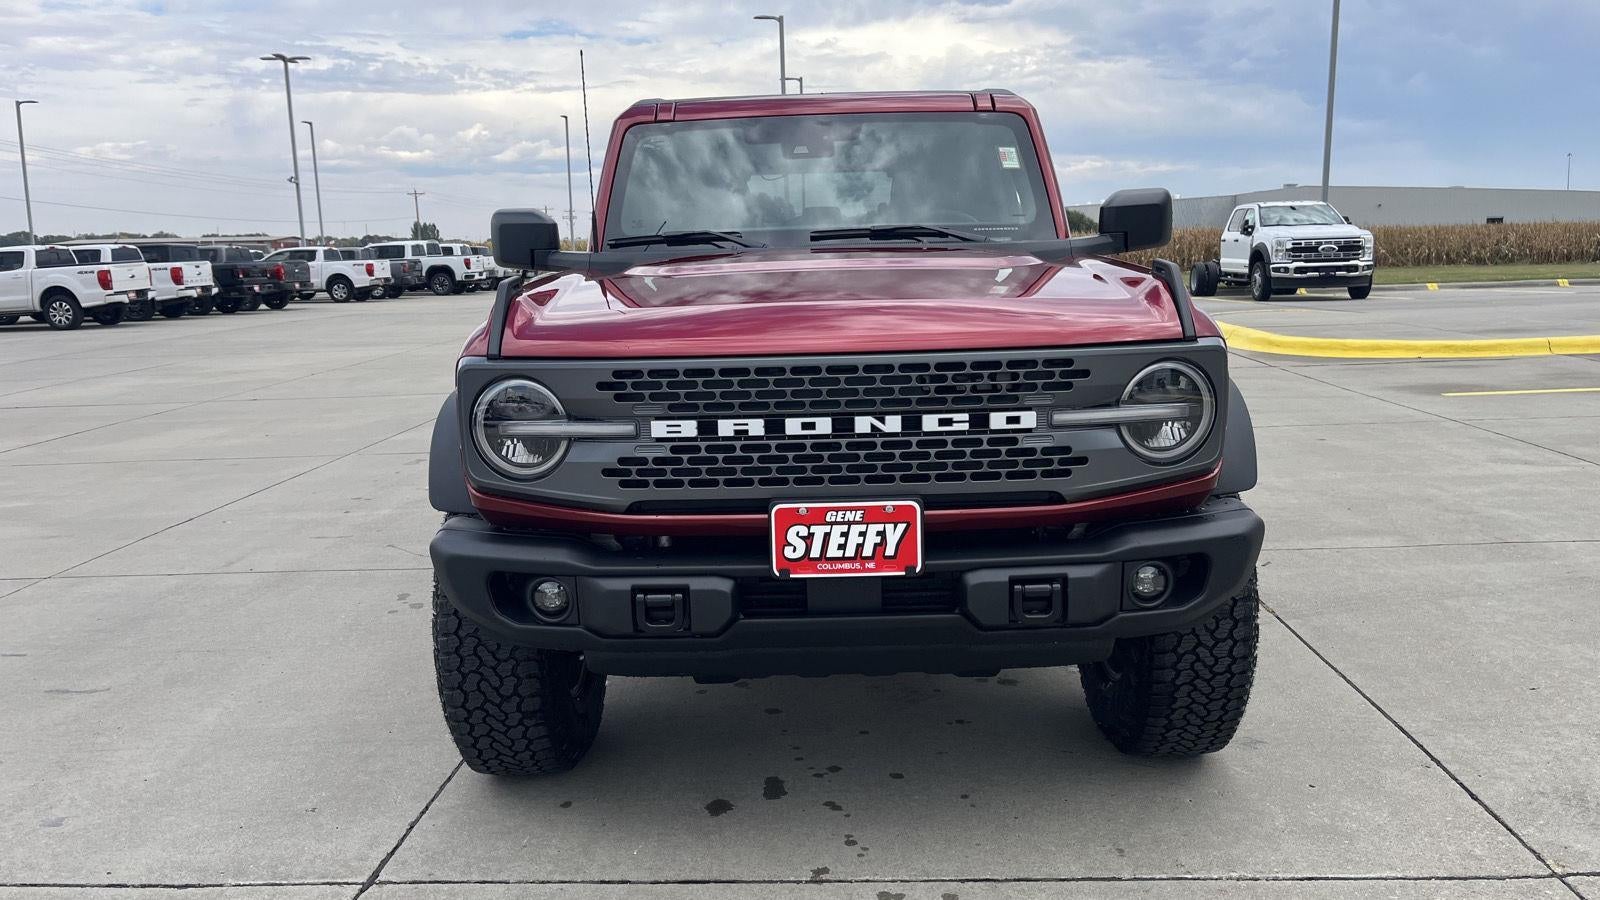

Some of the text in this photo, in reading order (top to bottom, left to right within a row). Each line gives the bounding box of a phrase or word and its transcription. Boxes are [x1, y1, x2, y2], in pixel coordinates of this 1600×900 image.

[650, 411, 1037, 437] BRONCO
[825, 510, 865, 522] GENE
[783, 523, 908, 560] STEFFY
[817, 562, 863, 570] COLUMBUS,
